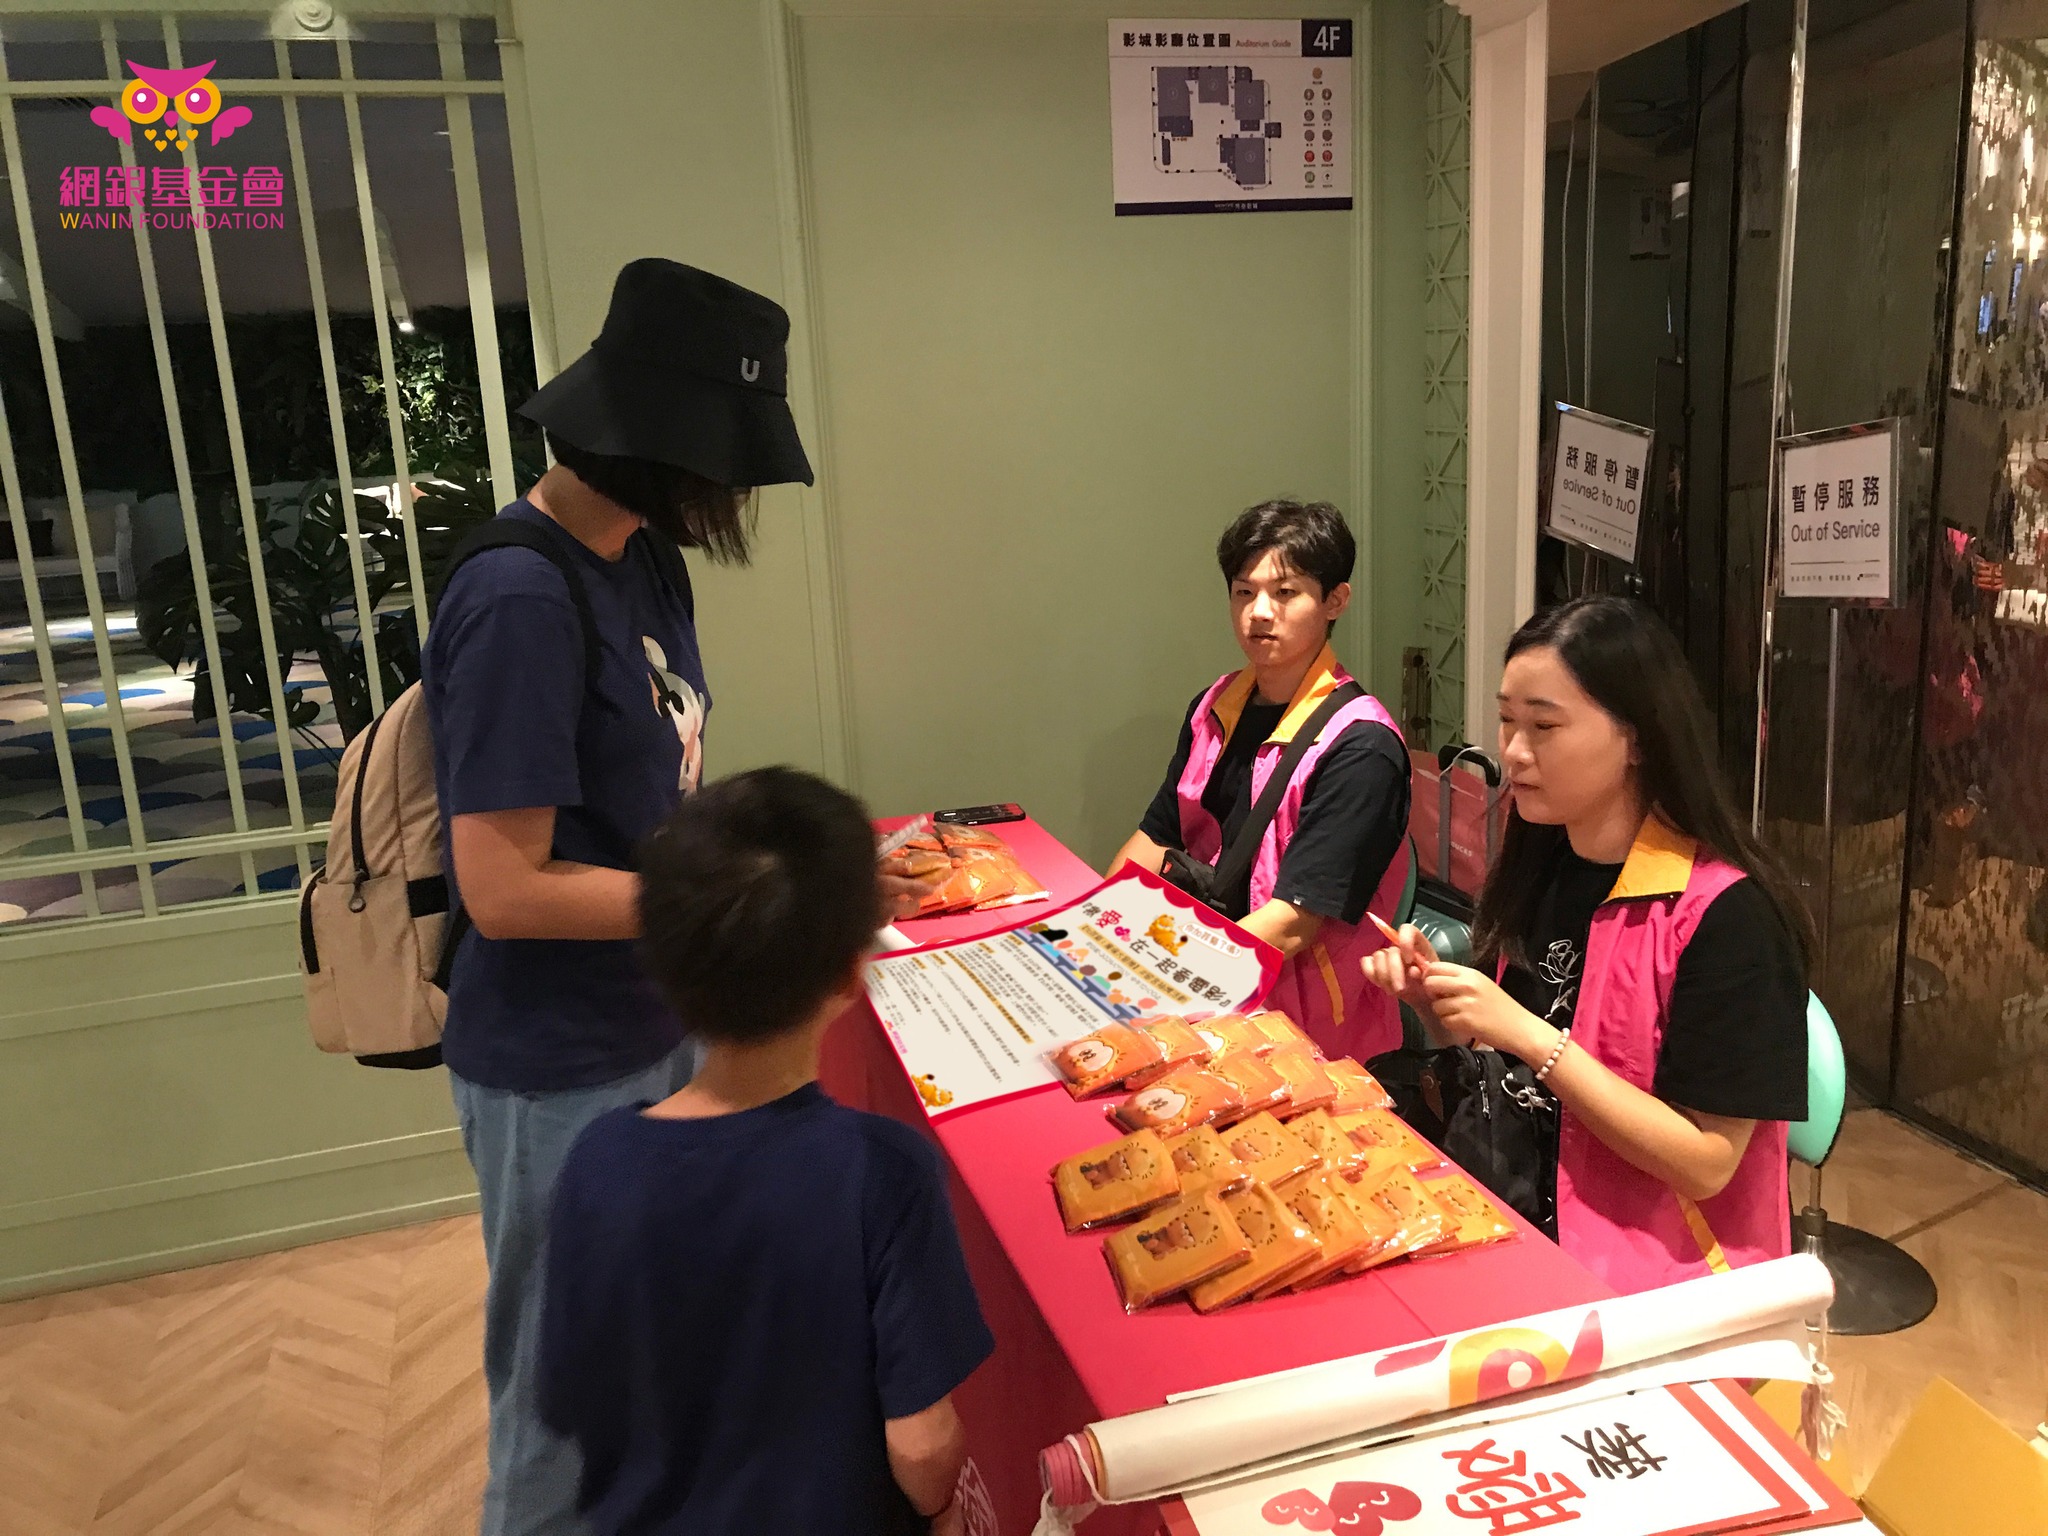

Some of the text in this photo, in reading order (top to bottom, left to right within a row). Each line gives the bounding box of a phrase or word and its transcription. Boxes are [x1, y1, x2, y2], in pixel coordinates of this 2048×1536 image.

[1123, 33, 1231, 47] 影城影廳位置圖
[1313, 25, 1340, 51] 4F
[741, 357, 760, 382] U
[1791, 475, 1880, 514] 暫停服務
[1791, 518, 1880, 543] Out of Service
